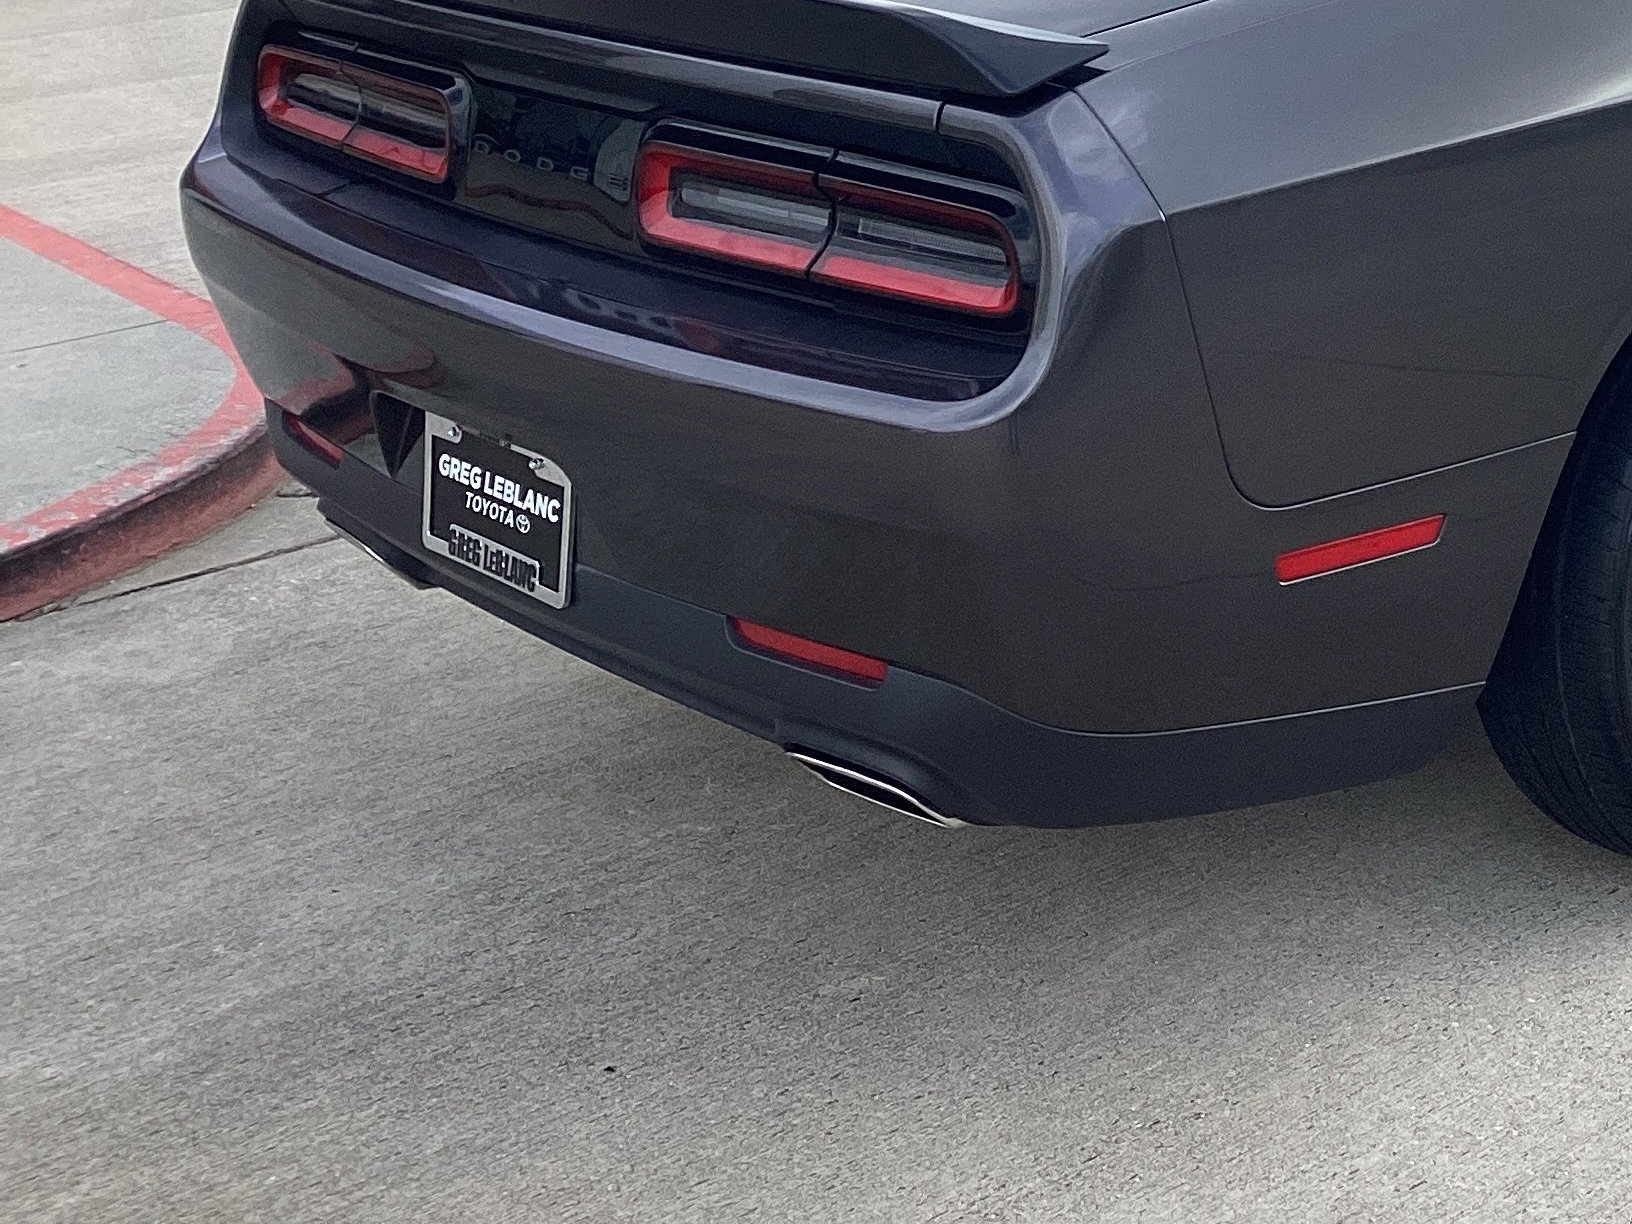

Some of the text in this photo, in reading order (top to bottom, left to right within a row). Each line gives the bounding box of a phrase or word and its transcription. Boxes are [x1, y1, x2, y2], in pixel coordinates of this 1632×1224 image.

[474, 139, 629, 192] DODGE
[438, 453, 561, 524] GREG LEBLANC
[465, 491, 515, 529] TOYOTA
[448, 528, 483, 568] GREG
